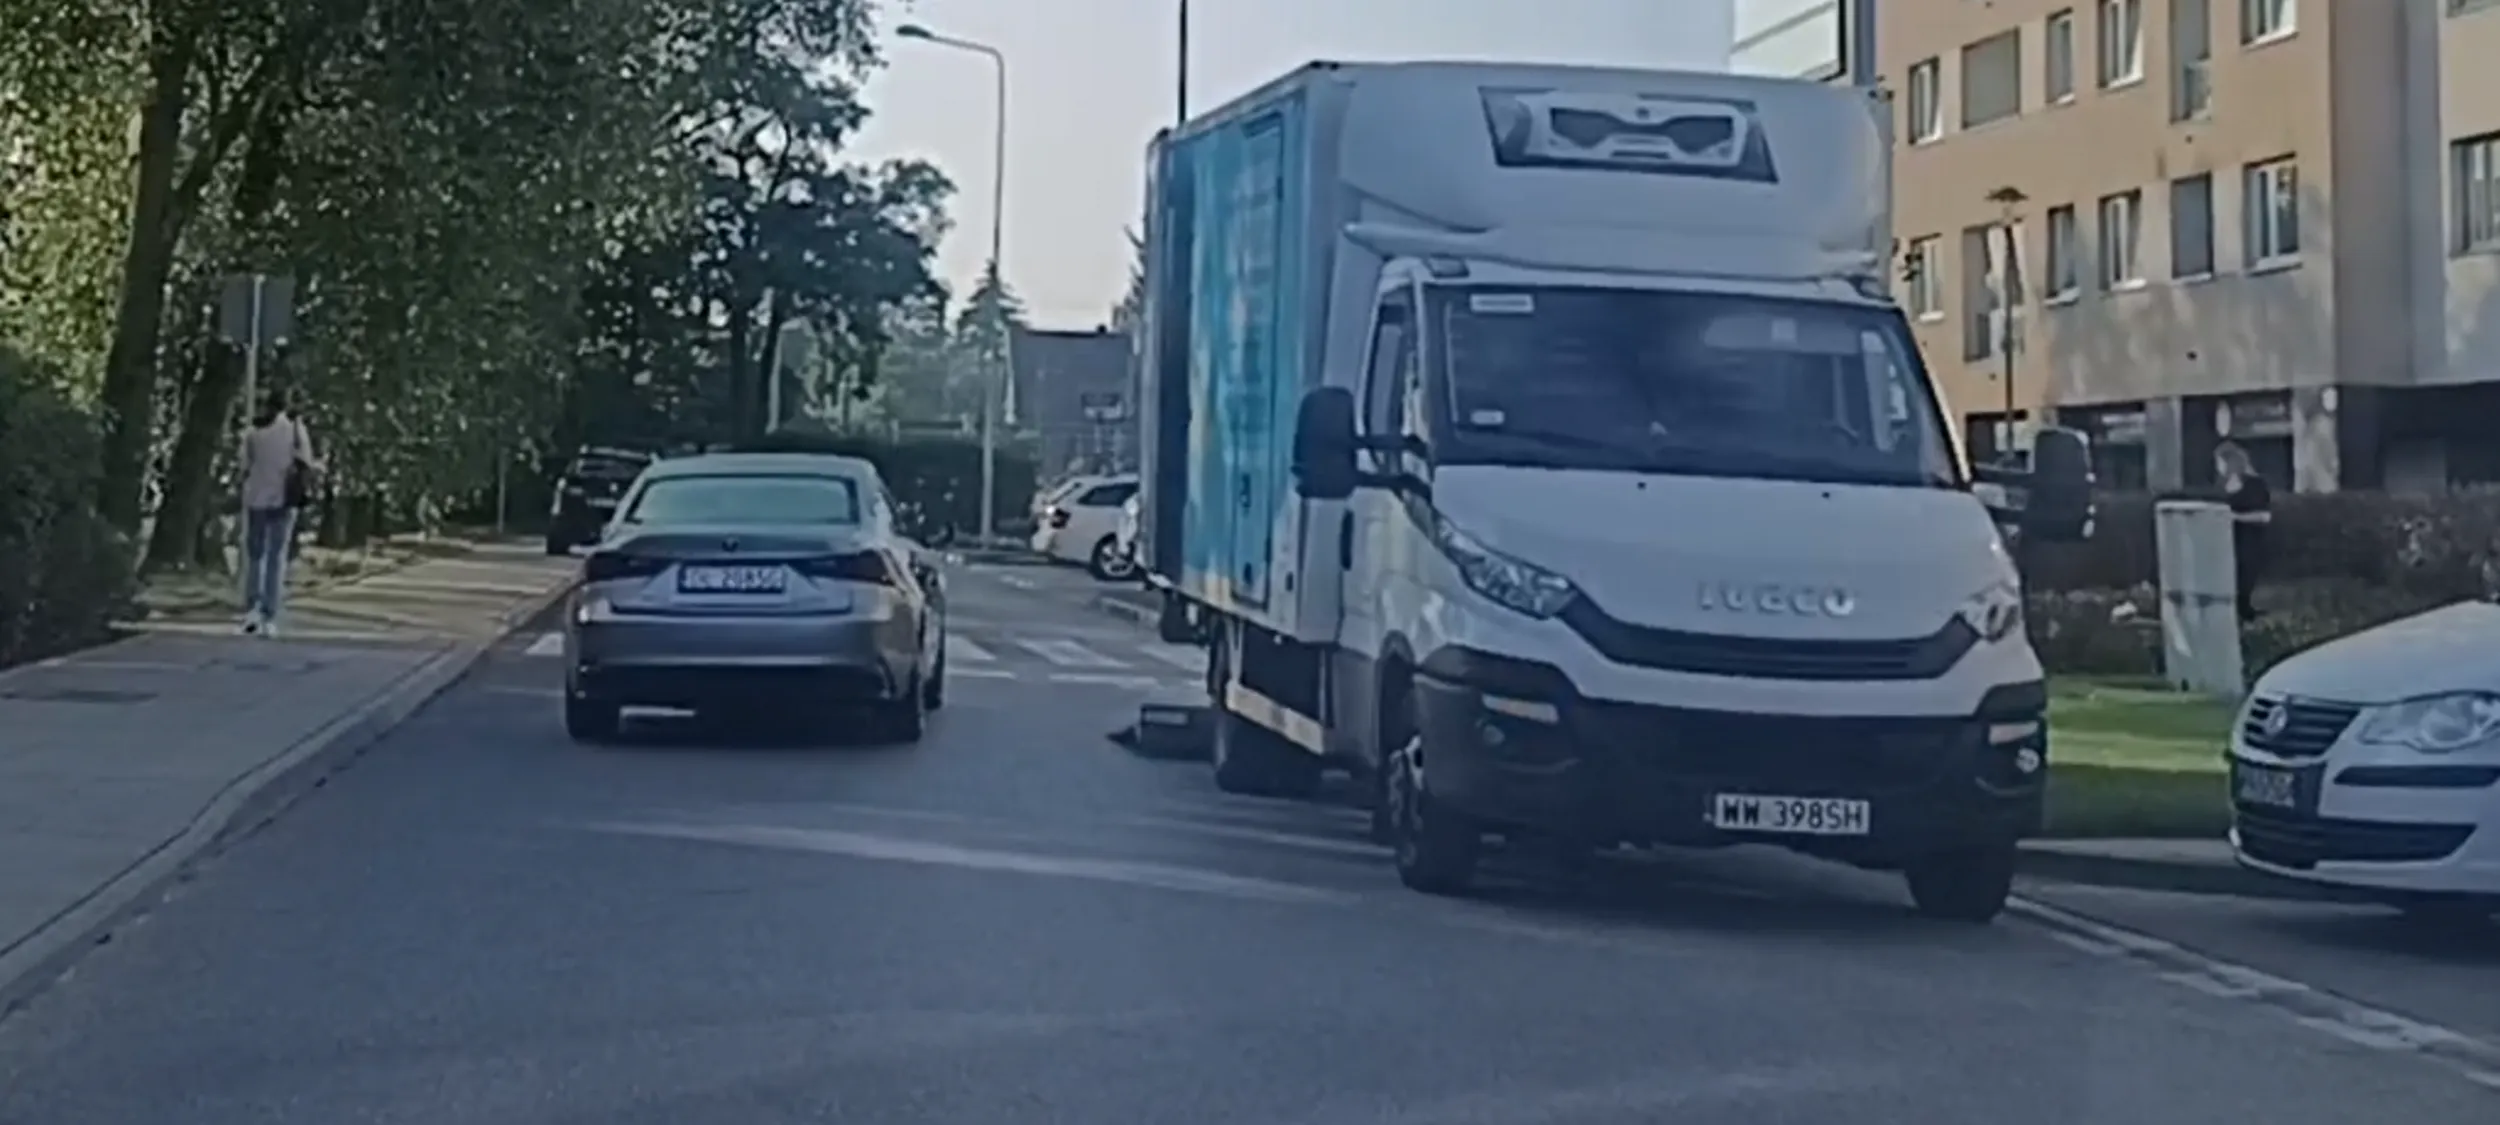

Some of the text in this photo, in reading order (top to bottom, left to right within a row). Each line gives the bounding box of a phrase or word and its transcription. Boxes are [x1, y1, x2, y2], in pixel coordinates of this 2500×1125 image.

[1698, 582, 1857, 618] IVECO
[1723, 799, 1862, 830] WW 398SH
